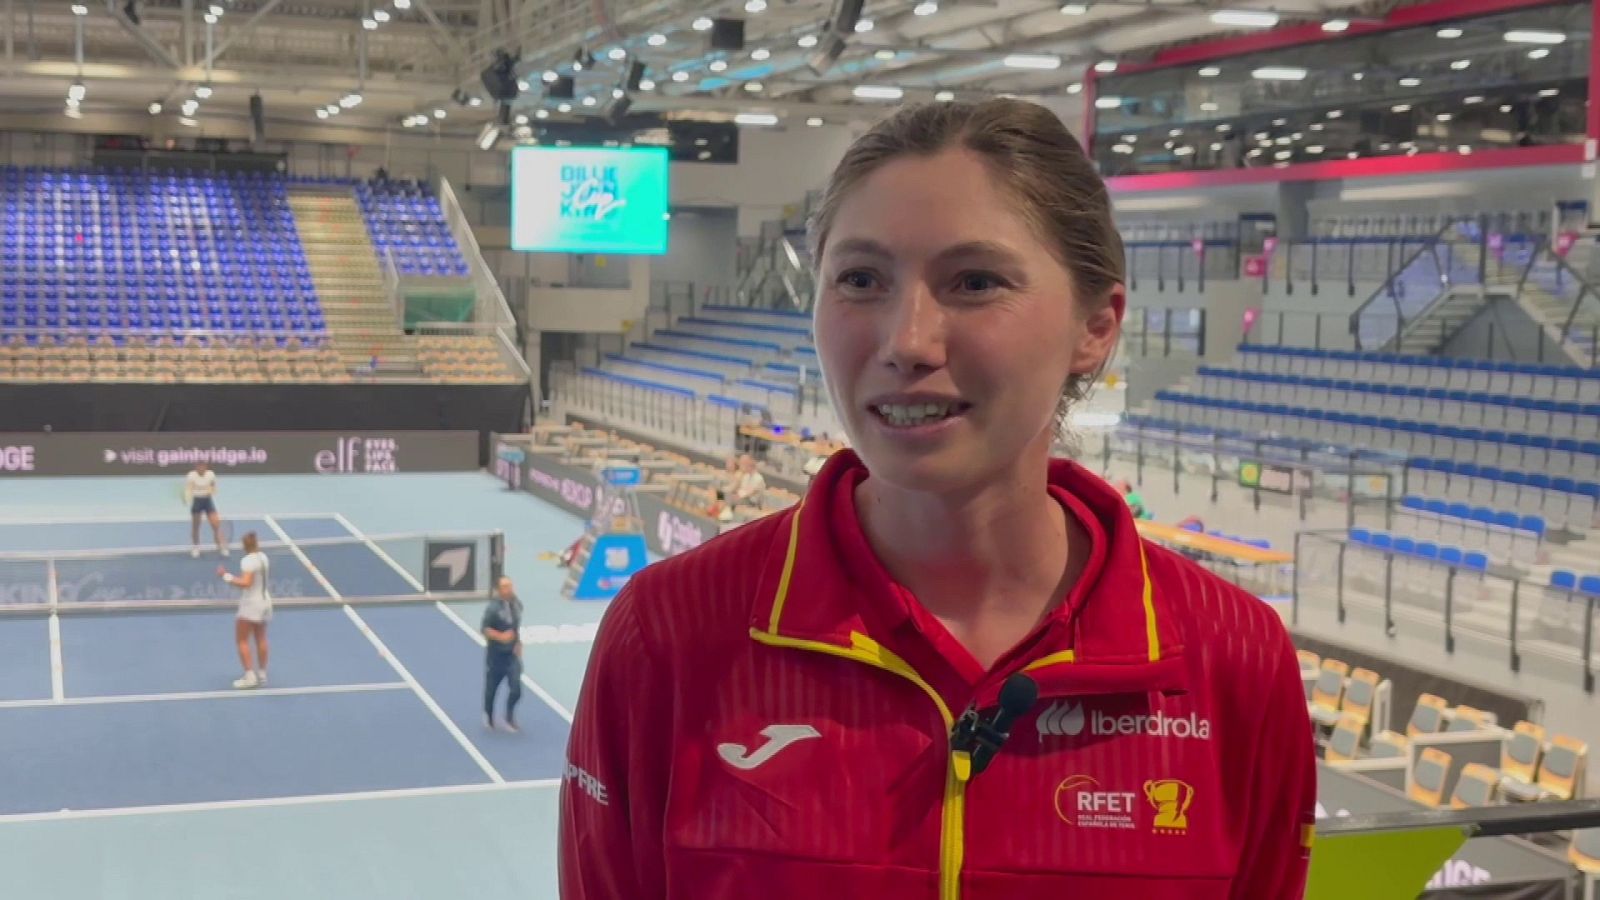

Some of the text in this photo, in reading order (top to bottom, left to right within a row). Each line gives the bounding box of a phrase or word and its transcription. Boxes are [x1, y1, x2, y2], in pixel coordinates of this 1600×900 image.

[121, 447, 268, 467] visit gainbridge.io
[1091, 709, 1211, 740] Iberdrola
[1077, 791, 1136, 813] RFET
